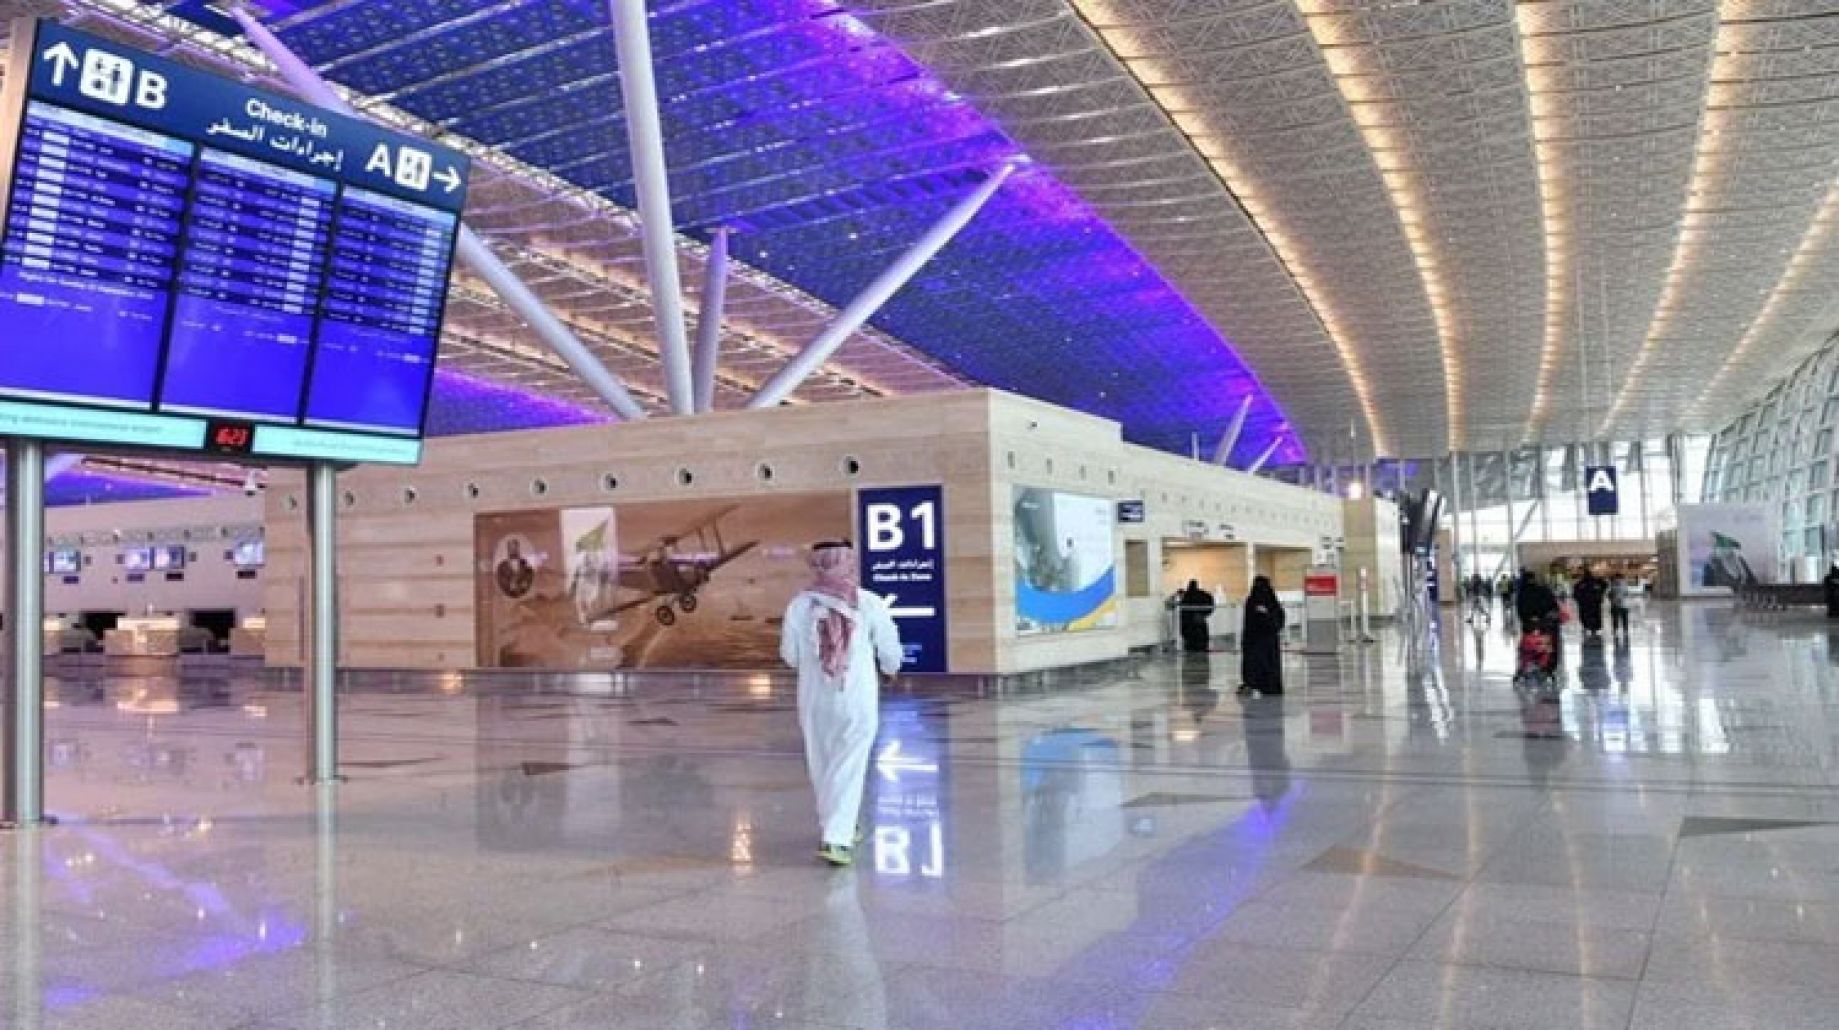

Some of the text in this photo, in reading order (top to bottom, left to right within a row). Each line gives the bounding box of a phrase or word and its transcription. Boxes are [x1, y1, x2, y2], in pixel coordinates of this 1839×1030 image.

[135, 71, 168, 109] B
[245, 98, 327, 138] Check-in
[365, 143, 391, 177] A
[1590, 469, 1614, 492] A
[867, 500, 935, 552] B1
